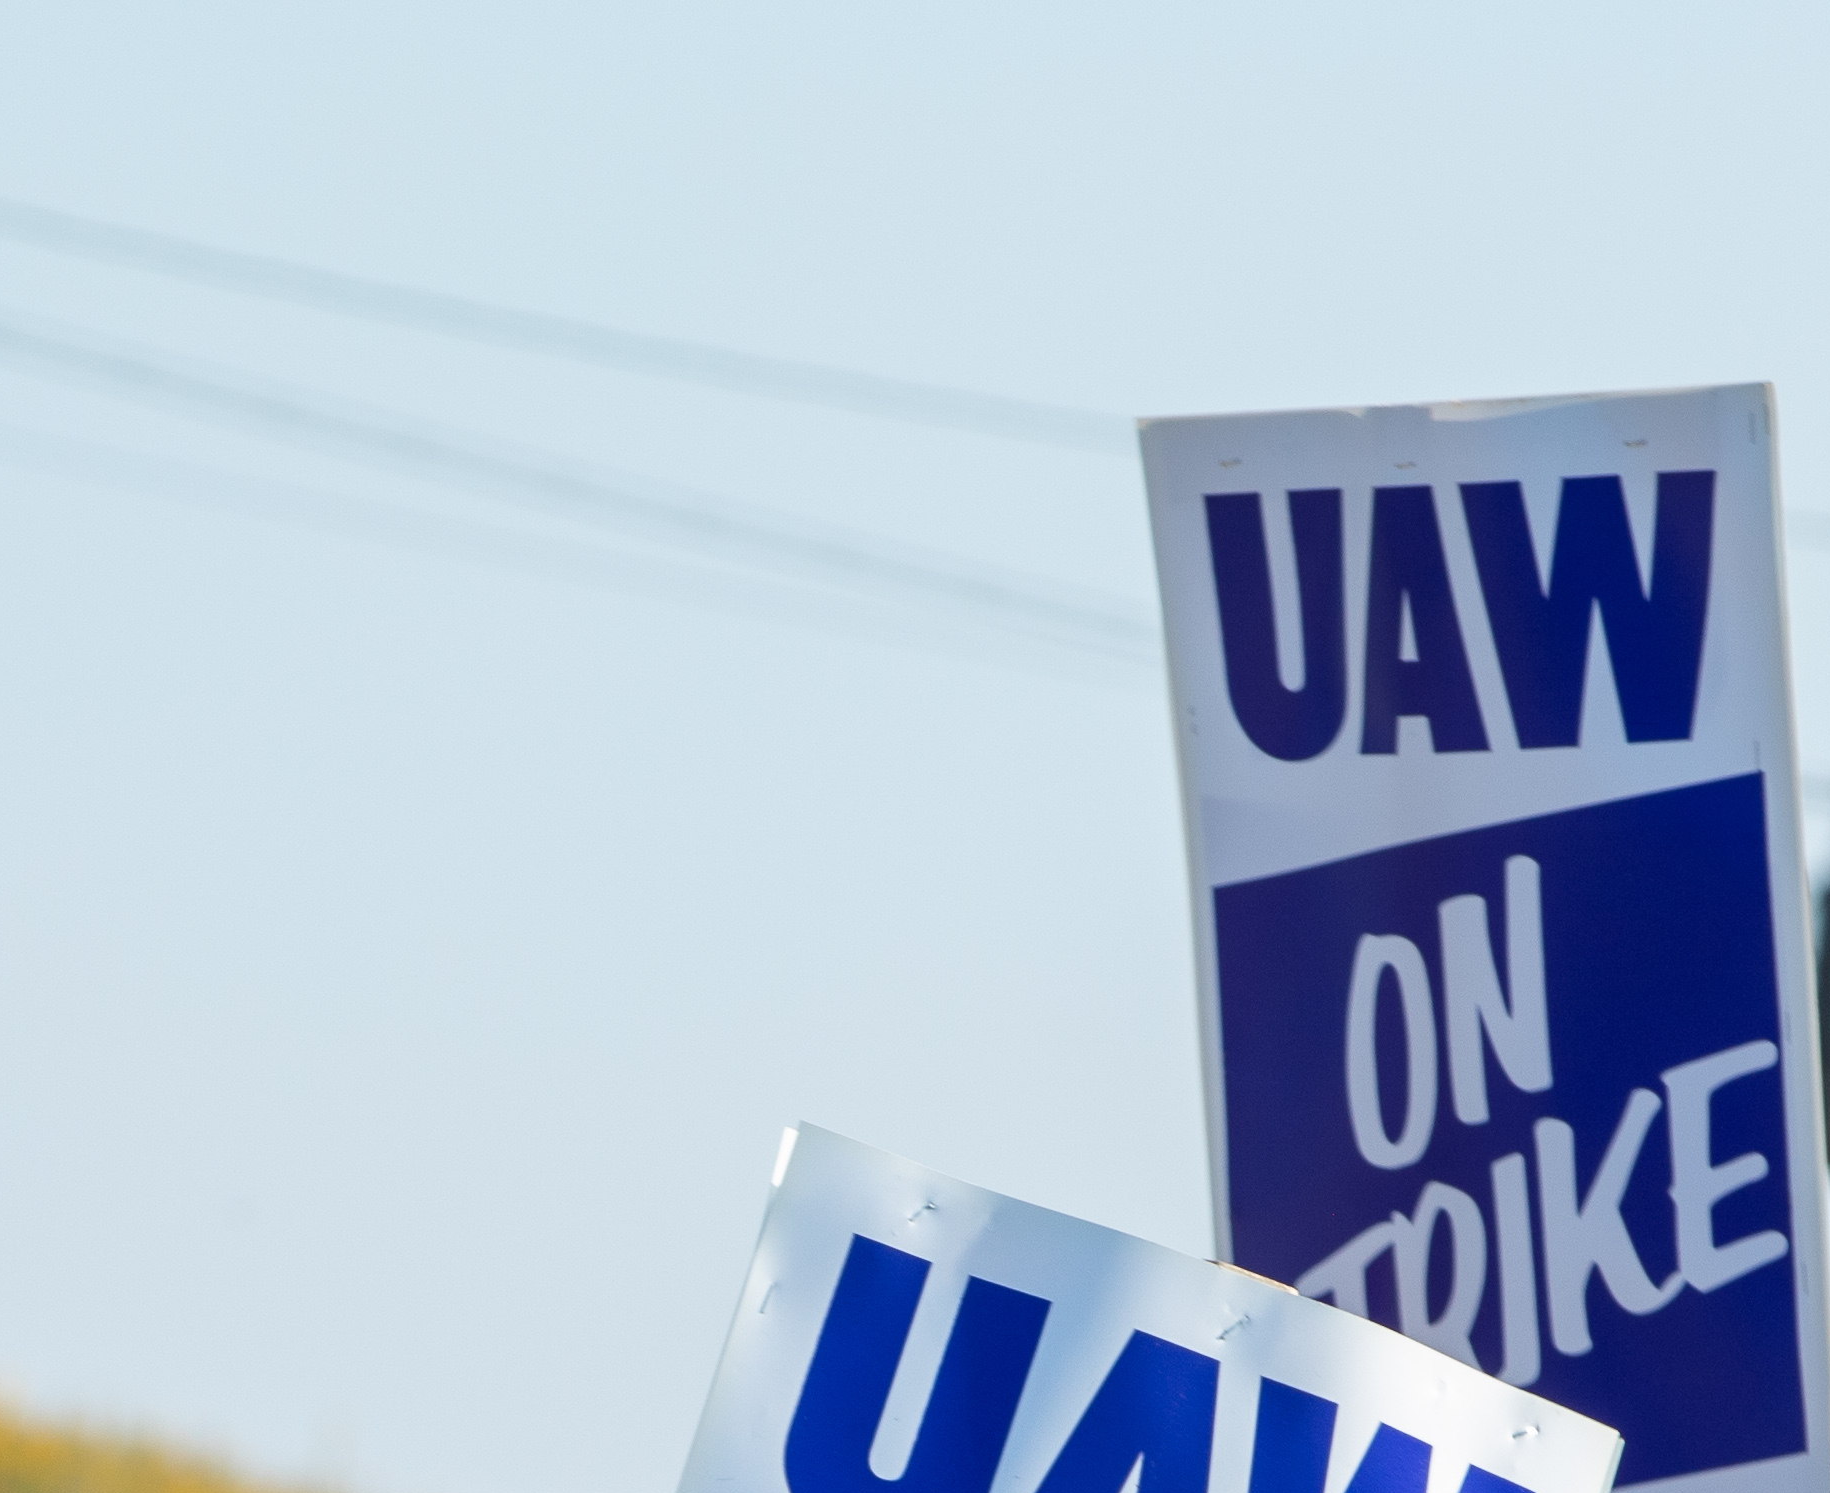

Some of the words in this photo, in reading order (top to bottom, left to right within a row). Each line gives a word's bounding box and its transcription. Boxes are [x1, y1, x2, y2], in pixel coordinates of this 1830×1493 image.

[1204, 469, 1717, 763] UAW
[1344, 854, 1554, 1170] ON
[1295, 1037, 1790, 1387] TRIKE
